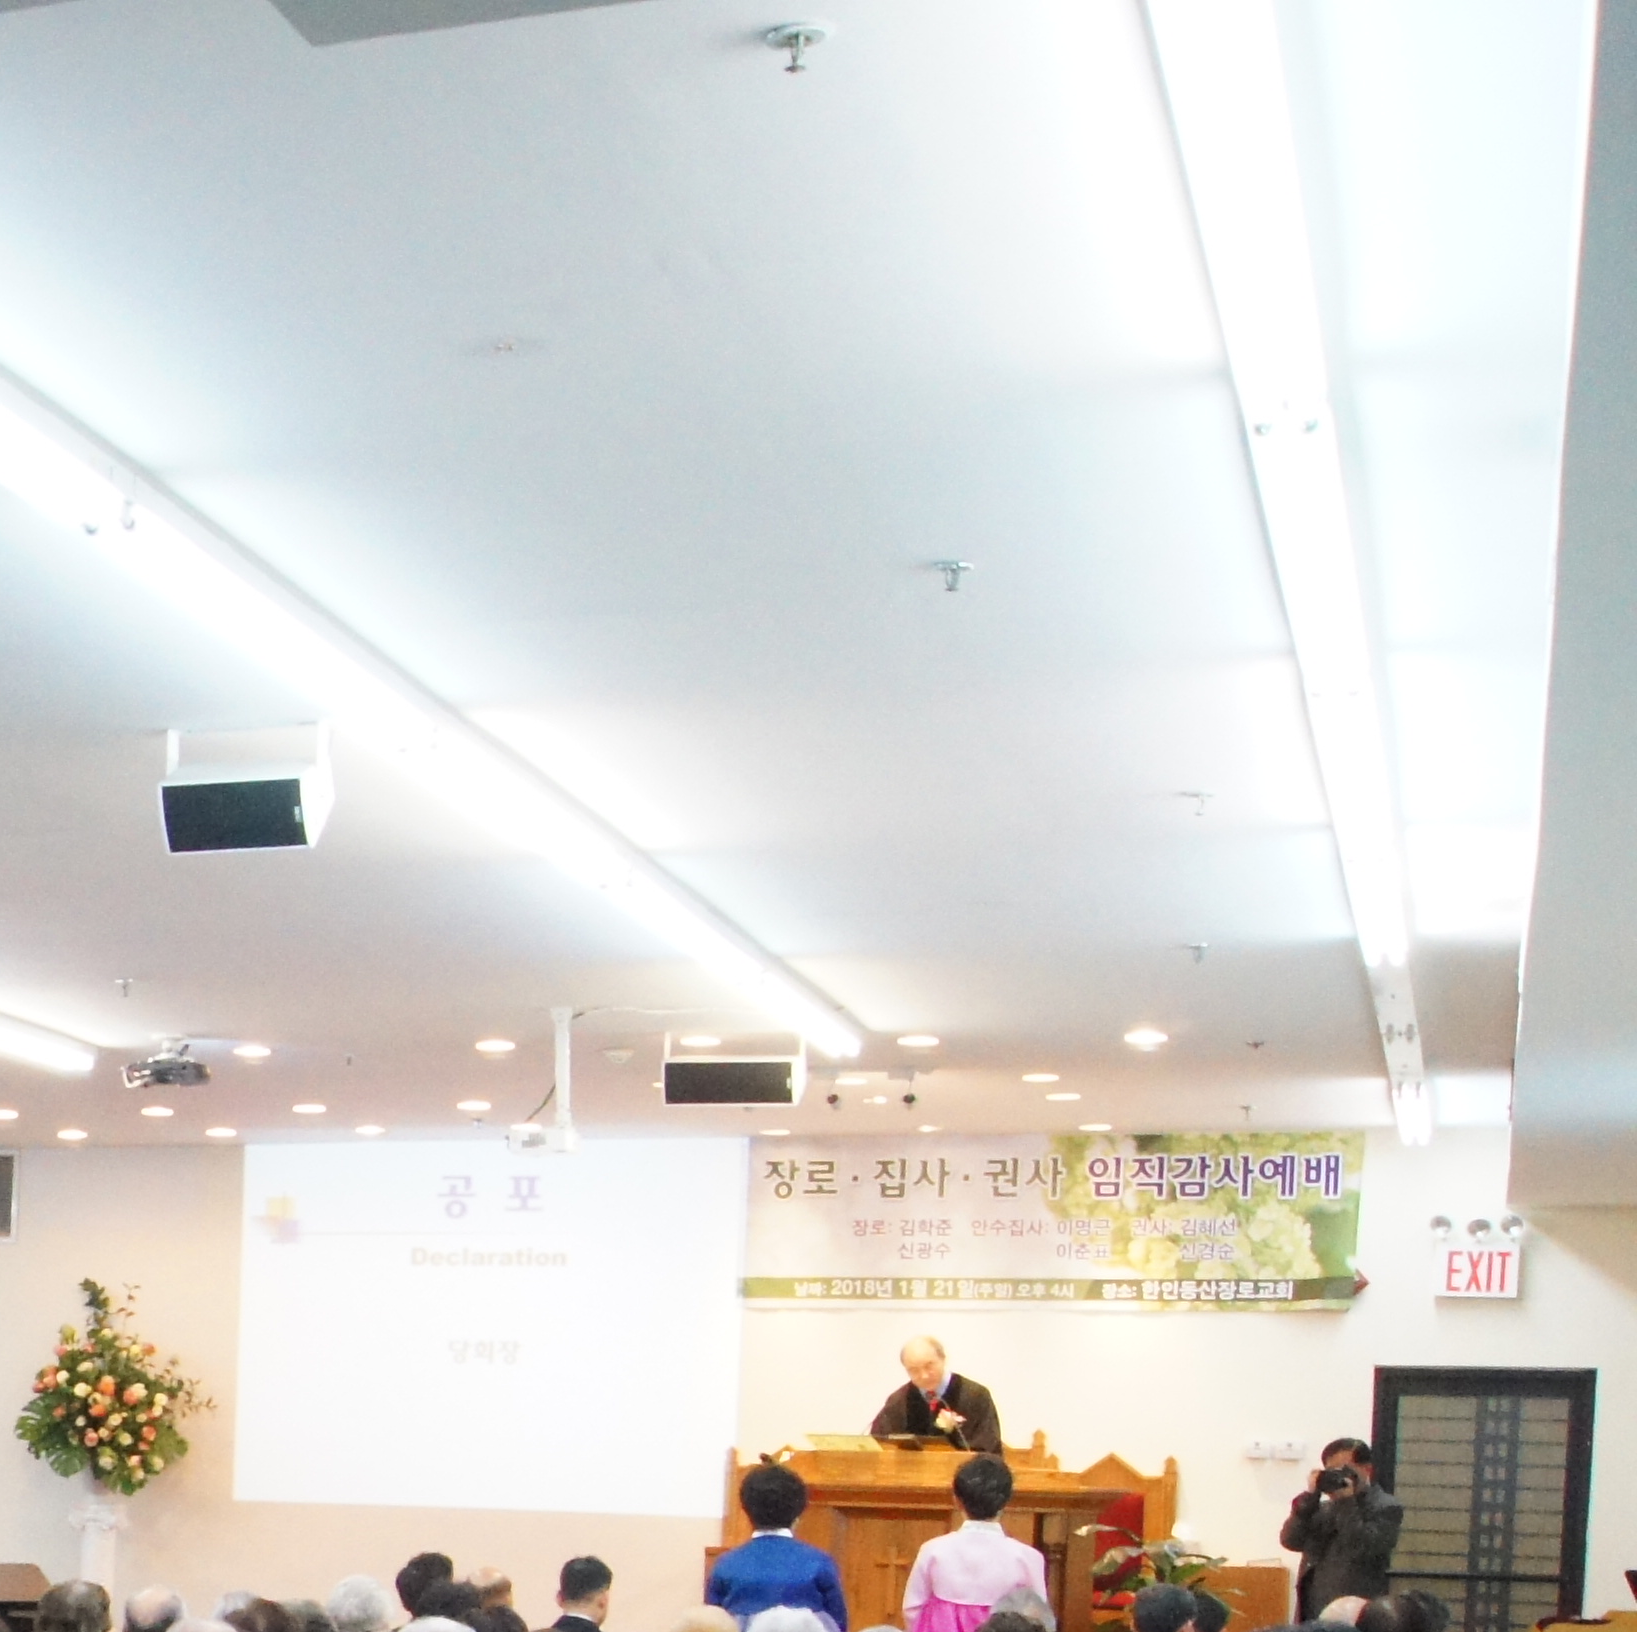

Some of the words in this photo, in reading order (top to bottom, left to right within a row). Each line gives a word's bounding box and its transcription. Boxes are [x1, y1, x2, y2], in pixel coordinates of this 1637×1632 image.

[764, 1158, 839, 1199] 장로
[873, 1157, 950, 1198] 집사
[983, 1157, 1063, 1198] 권사
[1087, 1154, 1341, 1198] 임직감사예배
[853, 1218, 893, 1237] 장로:
[899, 1218, 952, 1237] 김학준
[971, 1218, 1050, 1237] 안수집사:
[1057, 1218, 1111, 1237] 이명근
[1181, 1218, 1236, 1237] 김혜선
[411, 1247, 568, 1267] Declaration
[897, 1242, 951, 1260] 신광수
[1056, 1242, 1109, 1260] 이춘표
[1181, 1242, 1235, 1260] 신경순
[1445, 1250, 1513, 1293] EXIT
[830, 1279, 892, 1298] 2018년
[899, 1279, 927, 1298] 1월
[1016, 1282, 1047, 1298] 오후
[1049, 1282, 1075, 1298] 4시
[1141, 1279, 1293, 1300] 한인동산장로교회
[447, 1339, 522, 1366] 당회장
